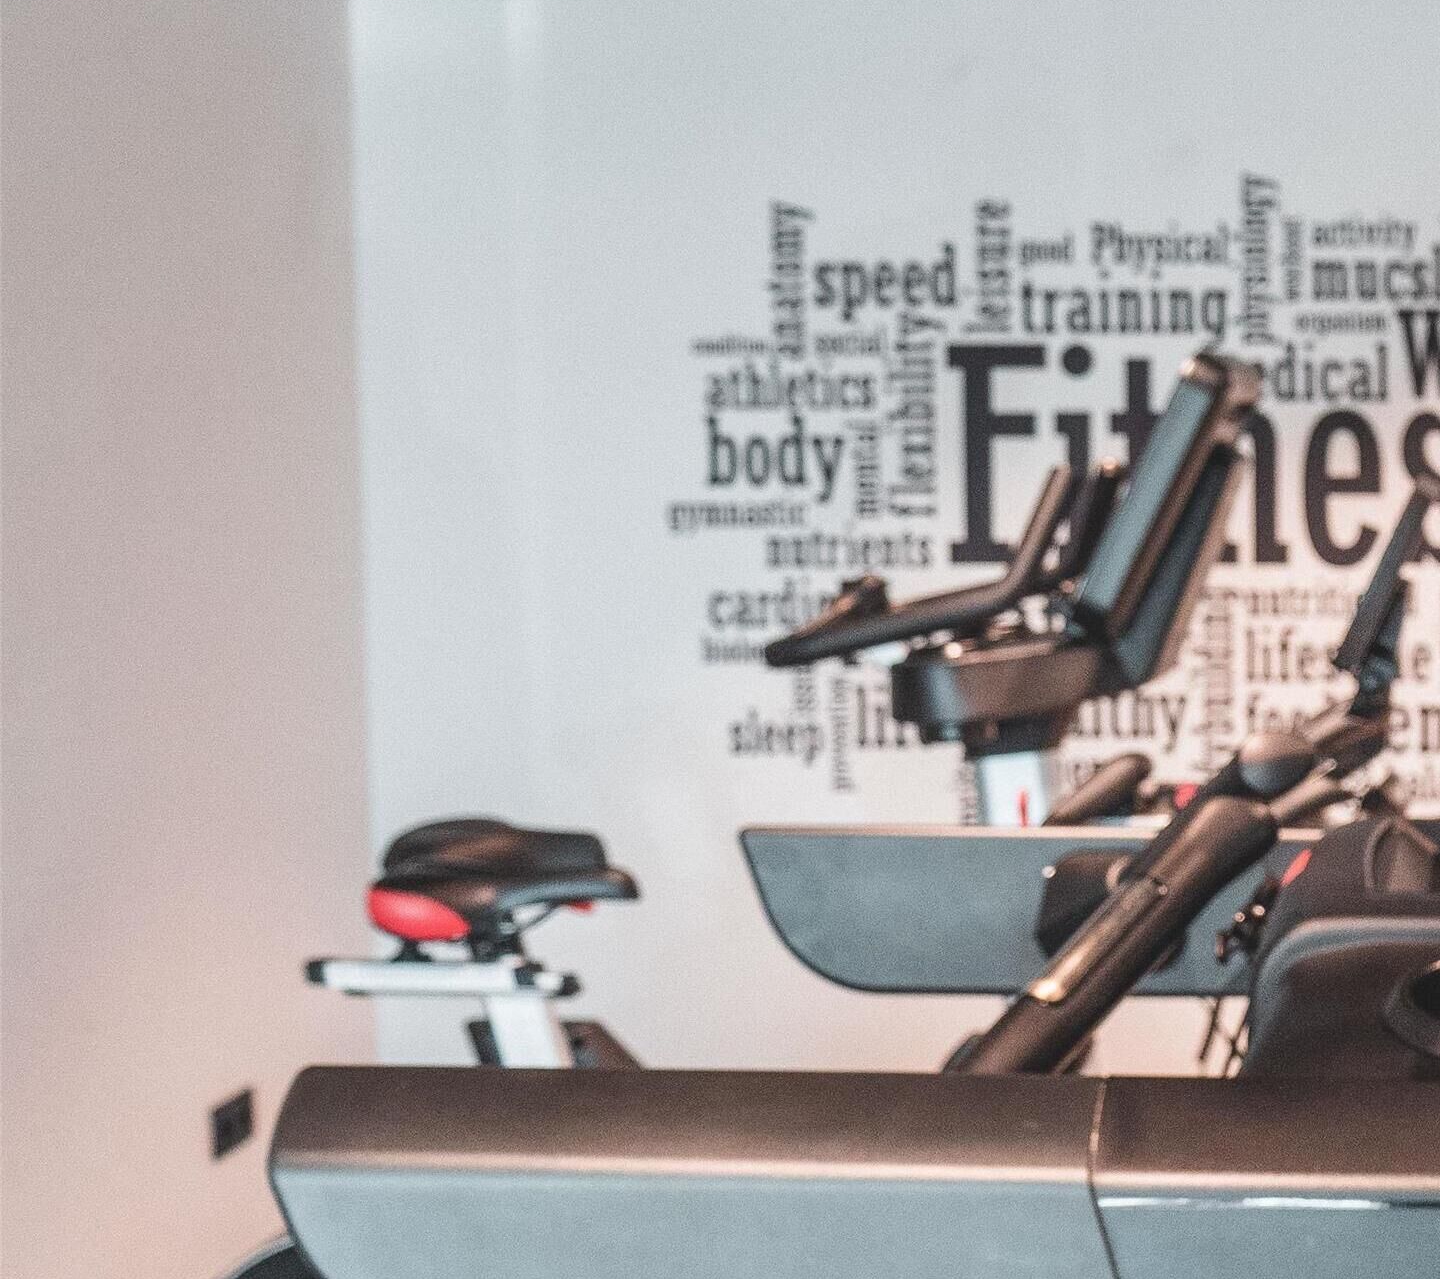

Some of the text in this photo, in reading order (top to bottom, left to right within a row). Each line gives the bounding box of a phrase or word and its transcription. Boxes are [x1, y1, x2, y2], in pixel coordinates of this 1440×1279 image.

[812, 240, 956, 323] speed
[1020, 268, 1229, 346] training
[707, 415, 845, 504] body
[729, 706, 822, 766] sleep
